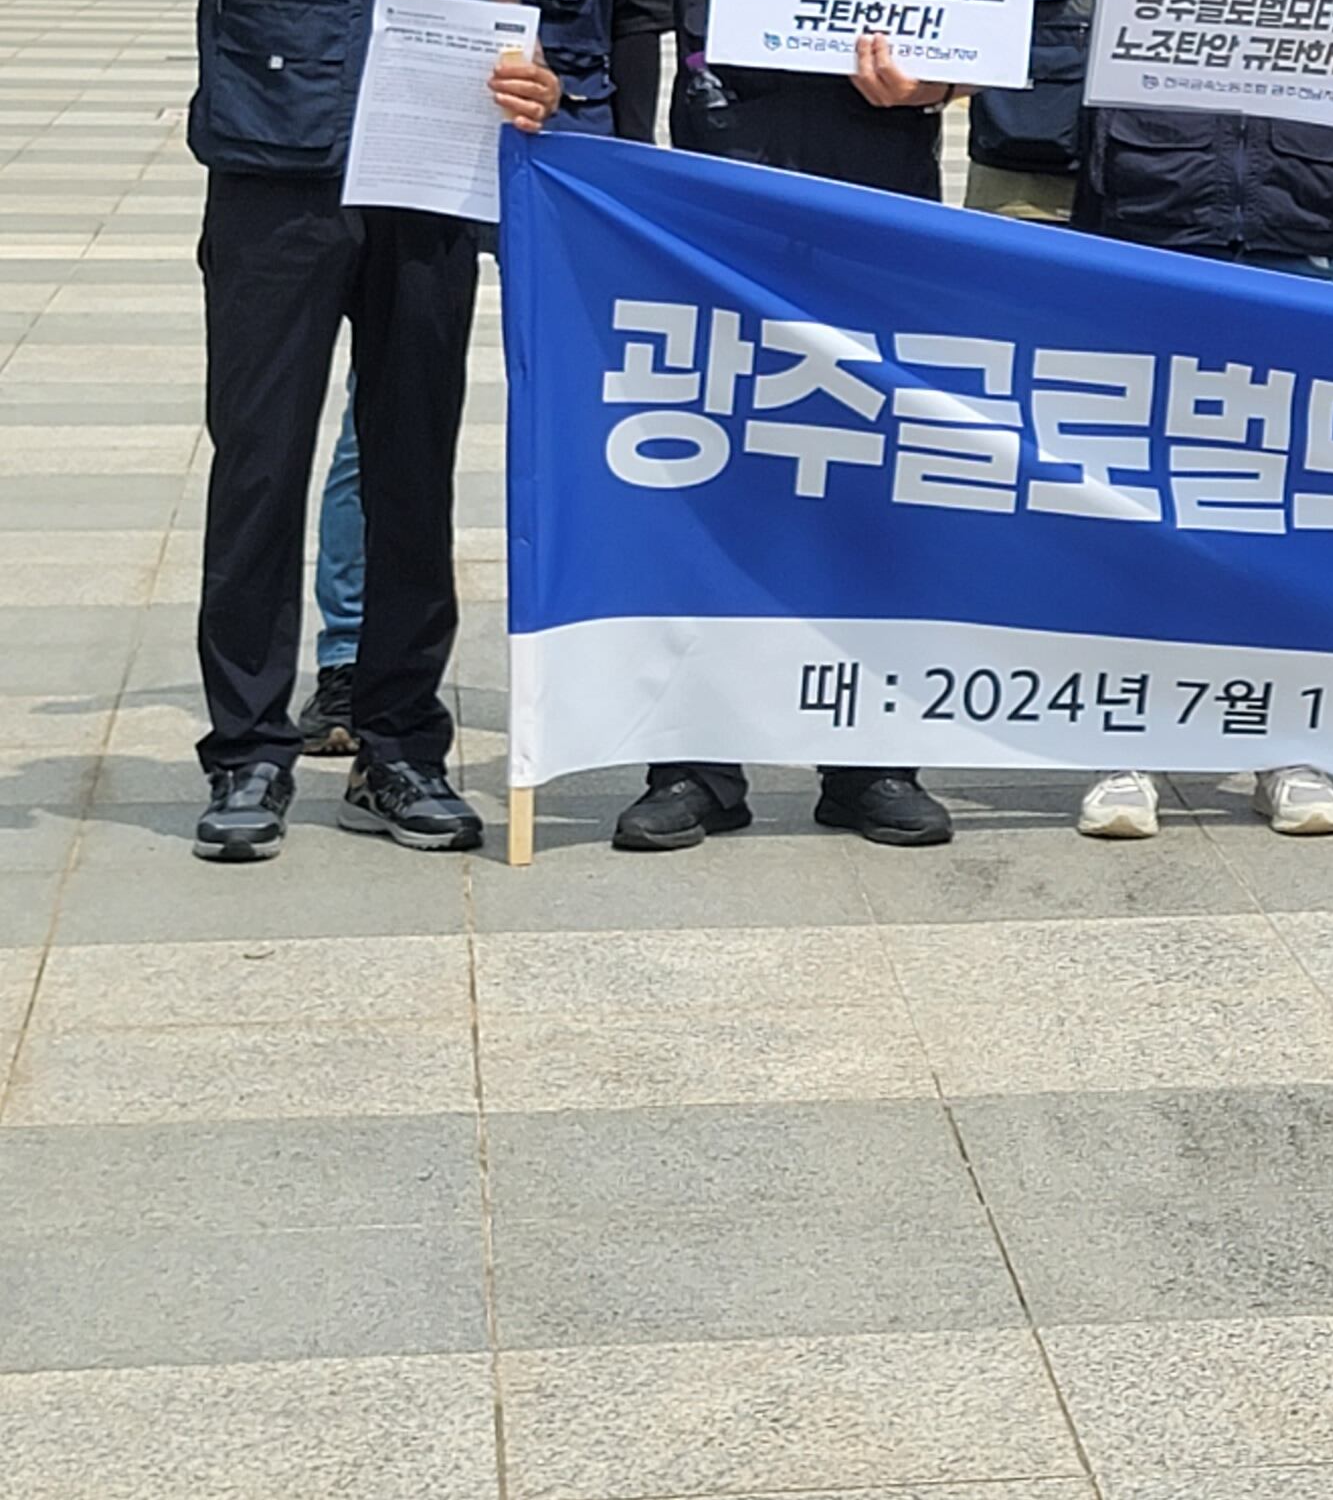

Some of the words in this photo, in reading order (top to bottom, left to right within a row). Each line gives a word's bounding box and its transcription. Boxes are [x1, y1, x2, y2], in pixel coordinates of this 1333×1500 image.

[1111, 27, 1240, 69] 노조탄압
[921, 666, 1149, 733] 2024년
[1175, 679, 1274, 737] 7월
